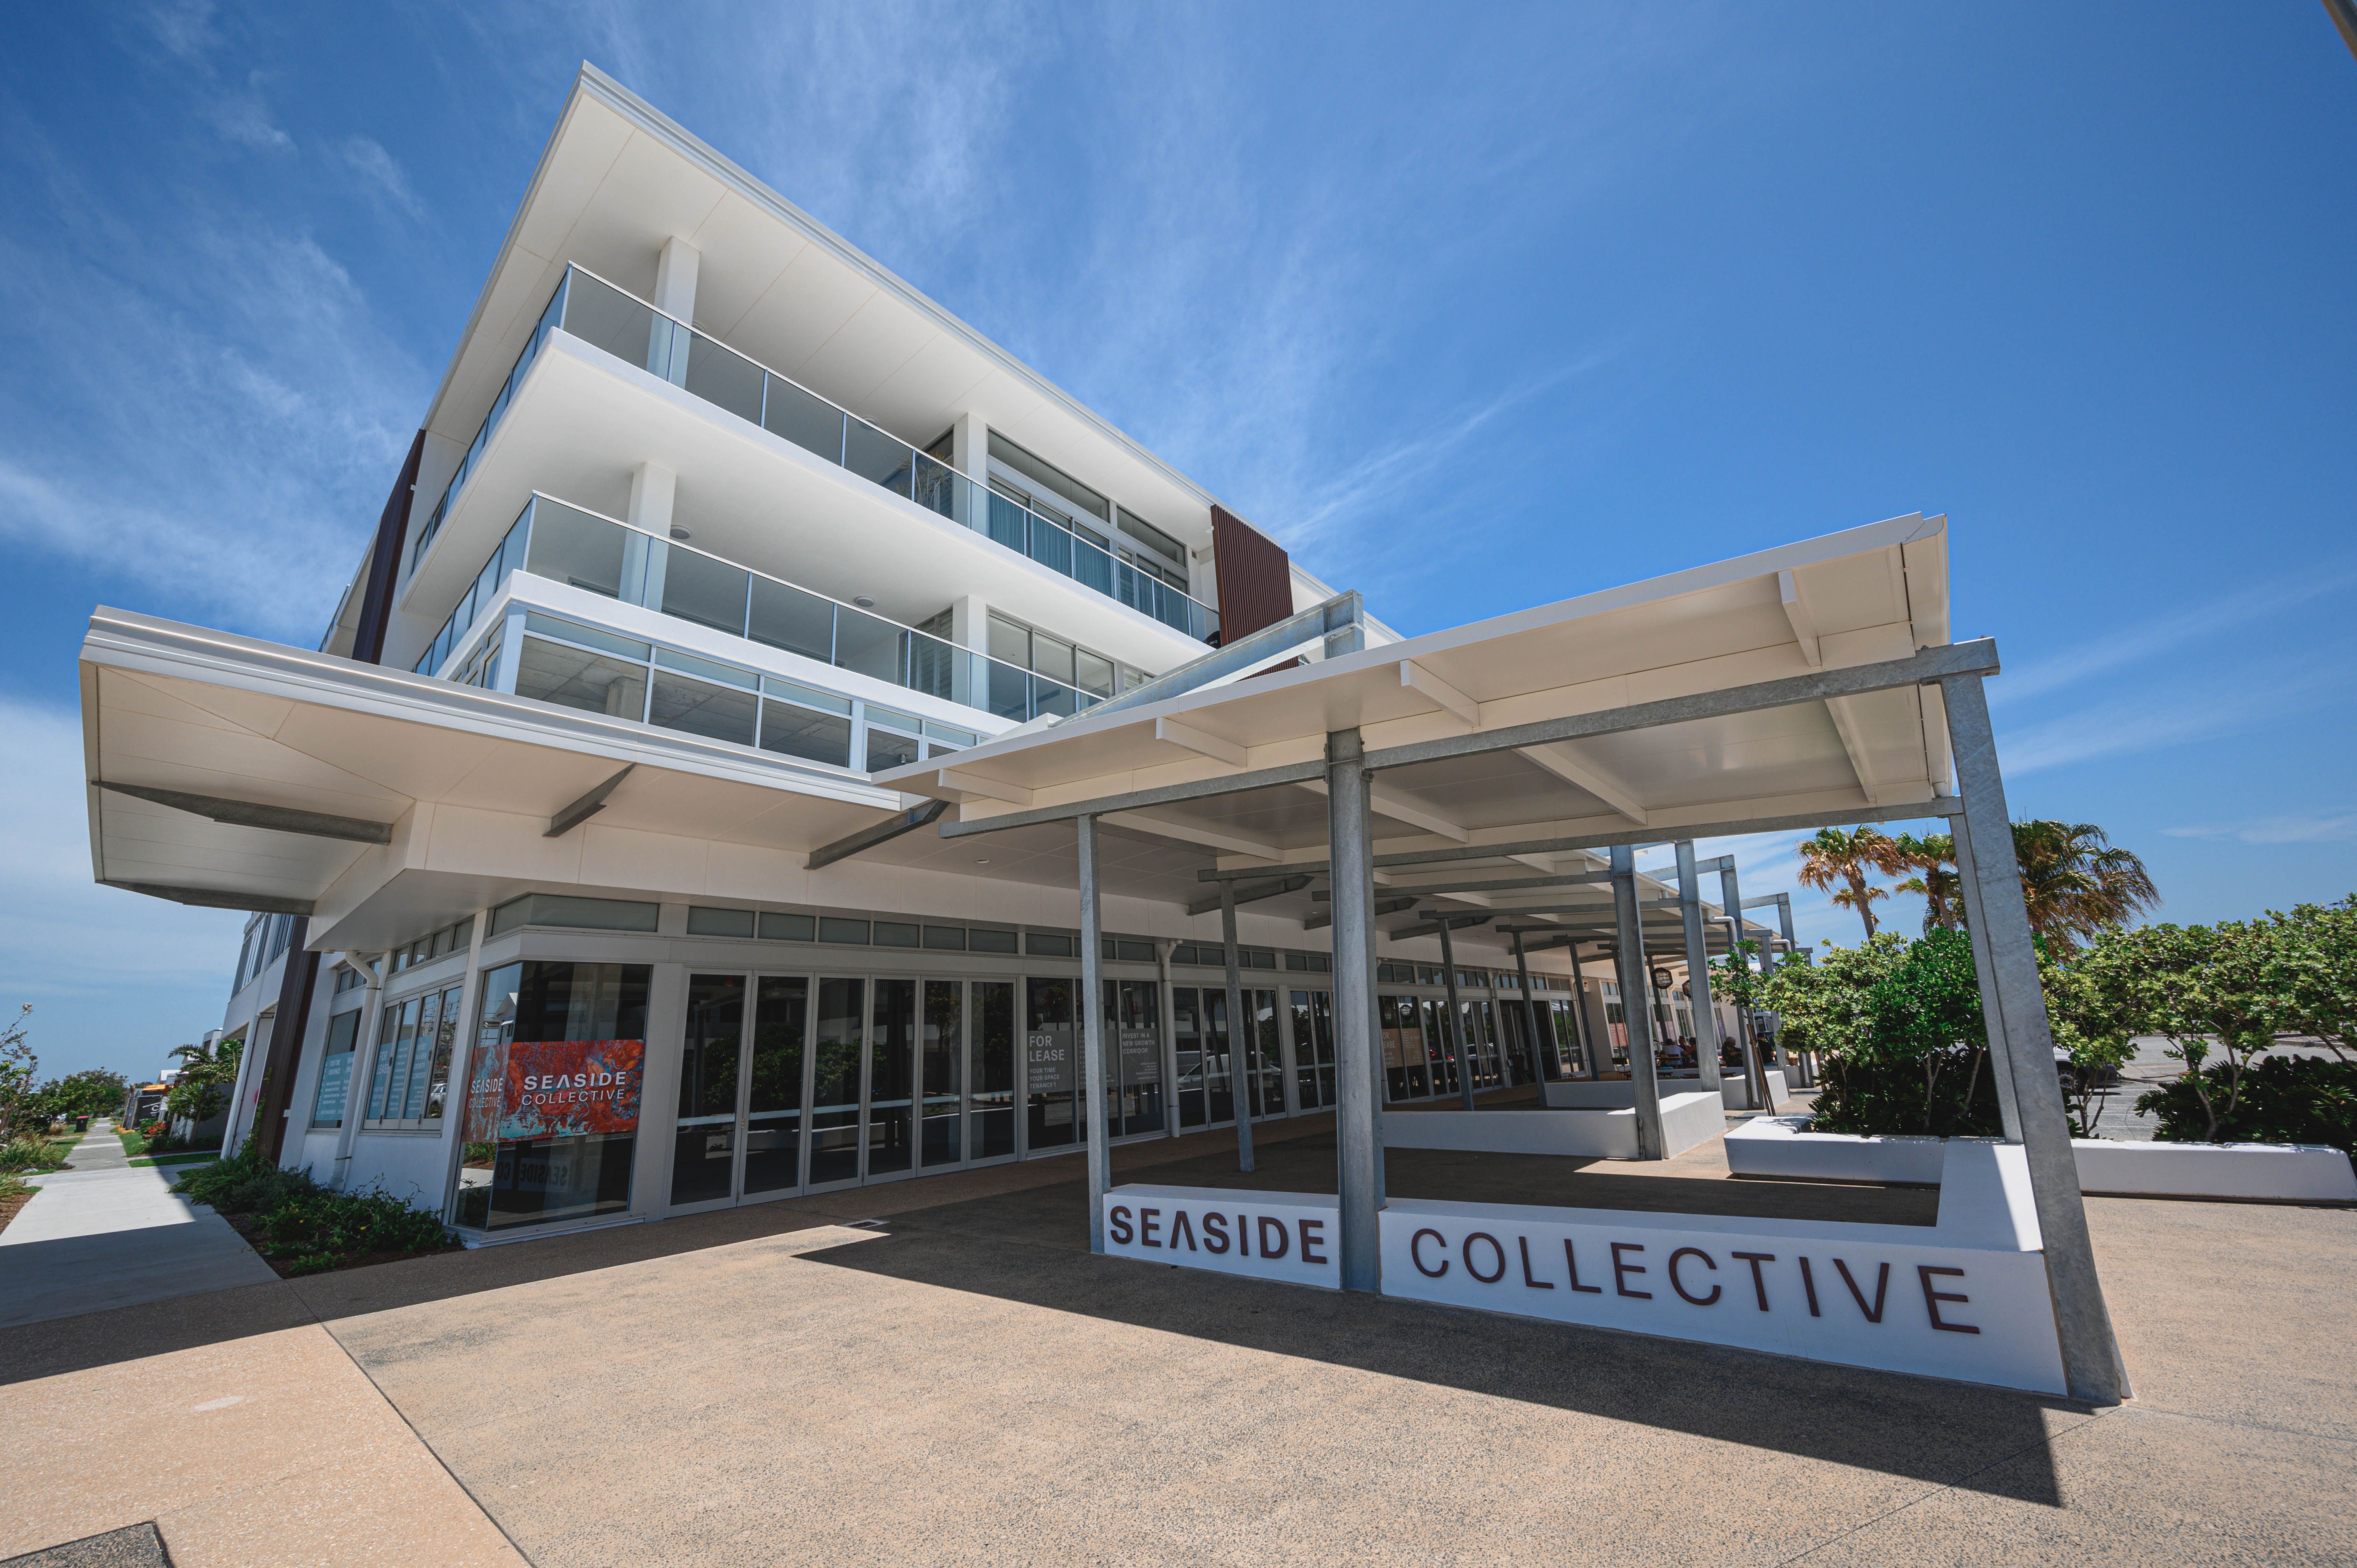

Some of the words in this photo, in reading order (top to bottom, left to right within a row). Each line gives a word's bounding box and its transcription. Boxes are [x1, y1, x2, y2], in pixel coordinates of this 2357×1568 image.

[1029, 1035, 1052, 1047] FOR
[379, 1051, 388, 1061] FOR
[1030, 1049, 1065, 1062] LEASE
[471, 1078, 503, 1094] SEASIDE
[524, 1072, 627, 1090] SEASIDE
[469, 1096, 501, 1108] COLLECTIVE
[522, 1089, 625, 1106] COLLECTIVE
[1110, 1205, 1328, 1264] SEASIDE
[1411, 1228, 1981, 1335] COLLECTIVE
